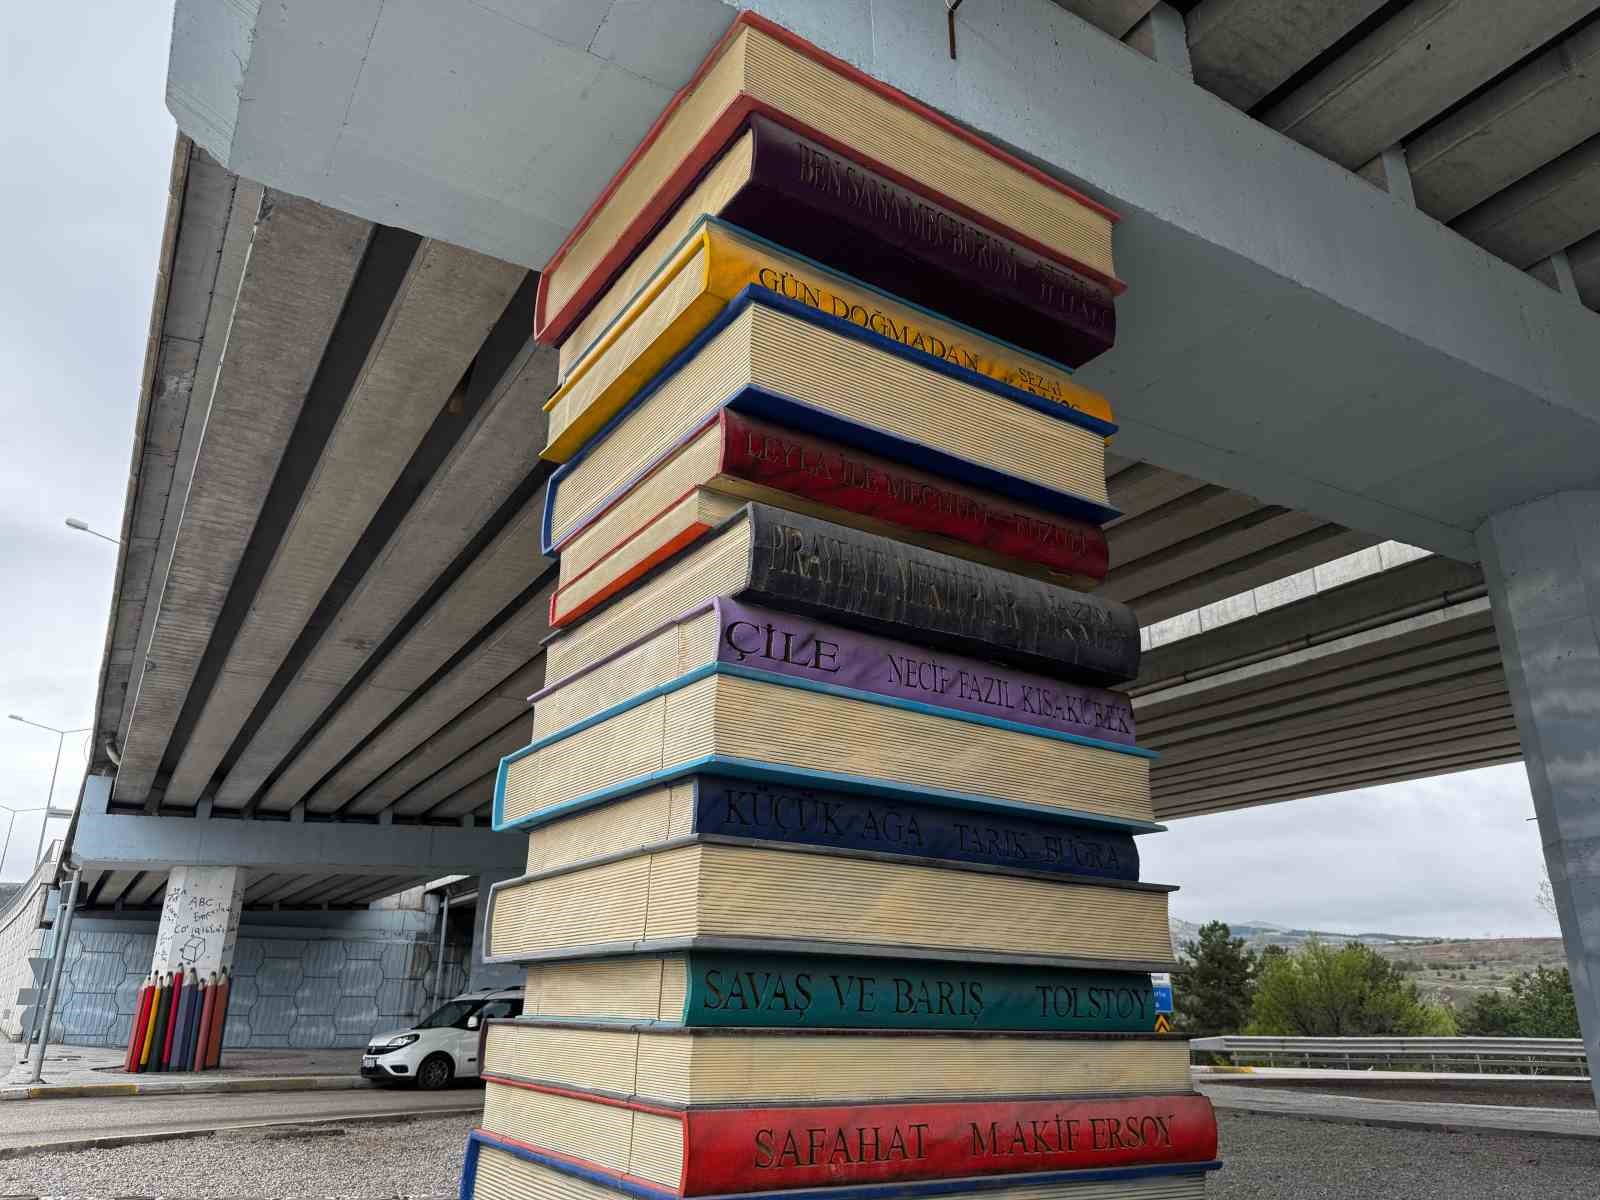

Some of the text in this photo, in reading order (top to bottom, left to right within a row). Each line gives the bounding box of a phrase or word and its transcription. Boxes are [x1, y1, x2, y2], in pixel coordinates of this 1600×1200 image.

[799, 142, 842, 198] BEN
[759, 267, 821, 309] GÜN
[832, 295, 979, 372] DOĞMADAN
[744, 431, 833, 481] LEYLA
[725, 621, 842, 673] ÇİLE
[958, 670, 1016, 710] FAZIL
[722, 784, 845, 837] KÜÇÜK
[861, 806, 924, 849] AĞA
[952, 823, 1027, 861] TARIK
[703, 968, 815, 1022] SAVAŞ
[829, 974, 877, 1013] VE
[894, 977, 985, 1026] BARIŞ
[1034, 984, 1150, 1020] TOLSTOY
[754, 1123, 930, 1169] SAFAHAT
[1088, 1115, 1176, 1151] ERSOY
